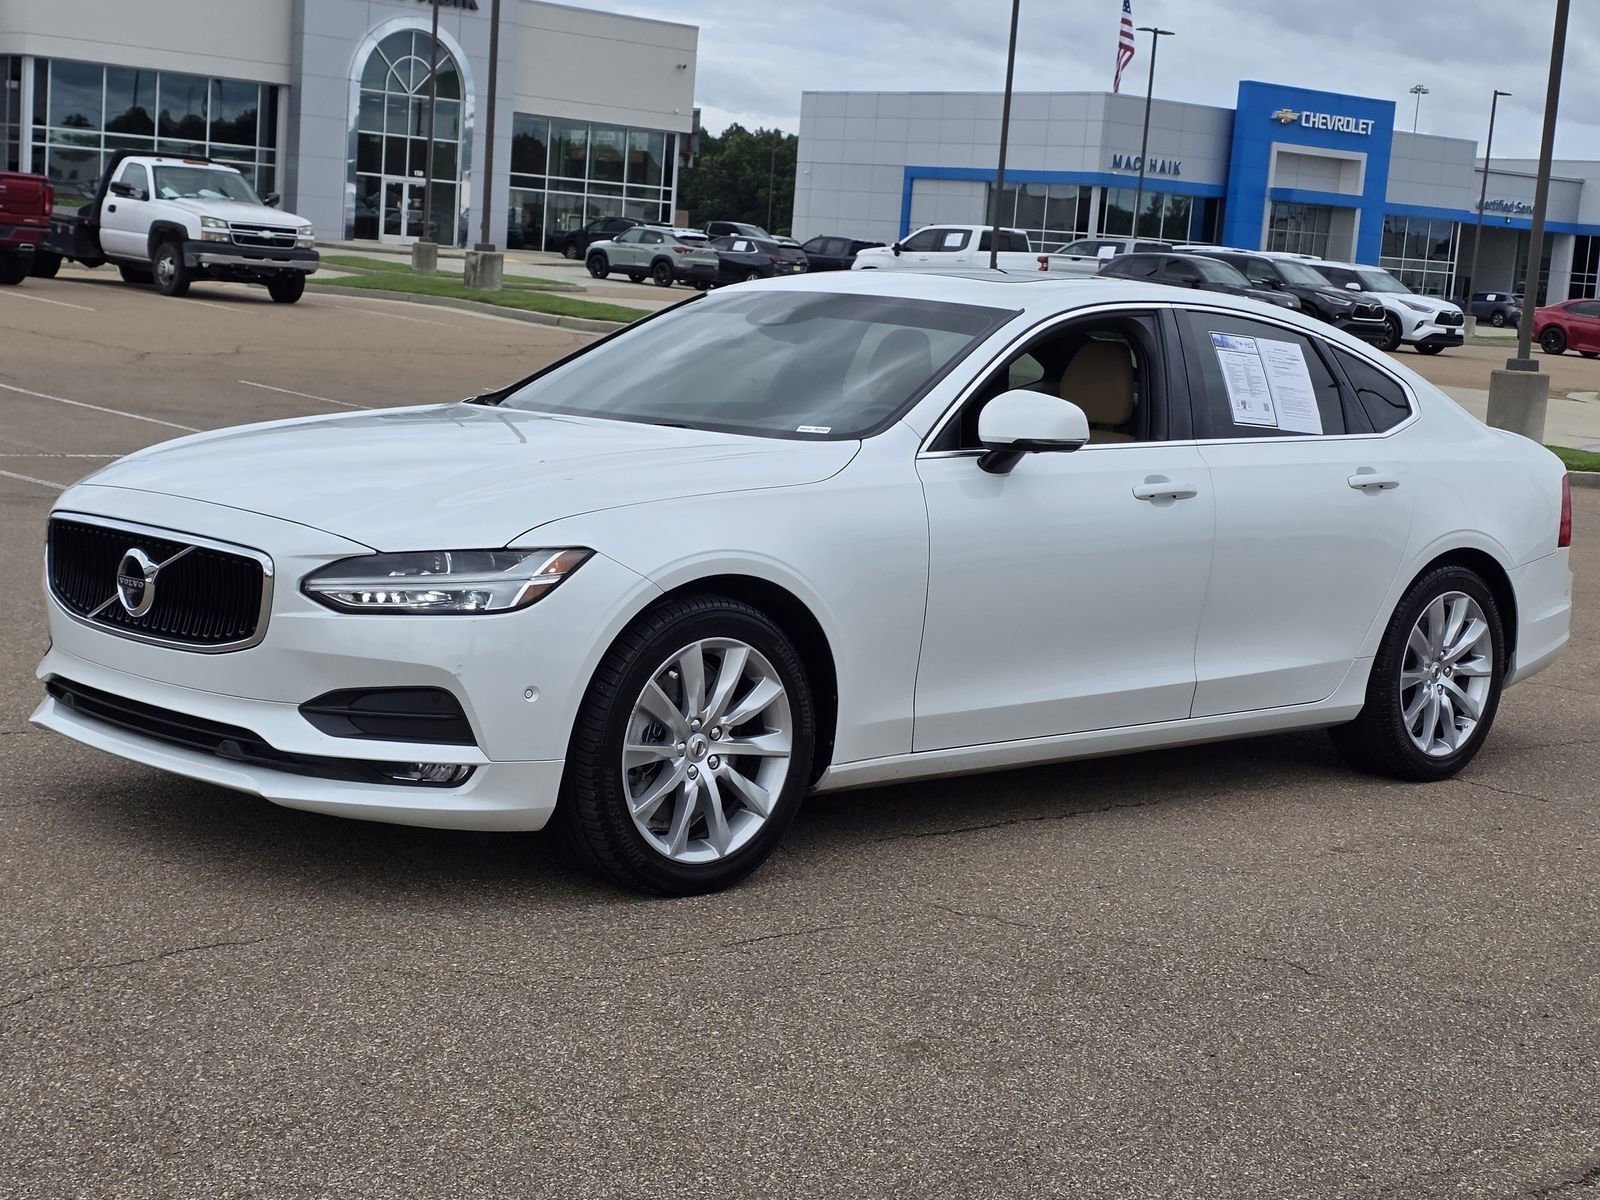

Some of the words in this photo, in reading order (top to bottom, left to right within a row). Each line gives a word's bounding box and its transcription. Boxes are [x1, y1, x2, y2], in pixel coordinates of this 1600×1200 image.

[1301, 111, 1375, 135] CHEVROLET
[1112, 154, 1142, 171] MAC
[1149, 158, 1182, 175] HAIK
[120, 577, 144, 588] VOLVO
